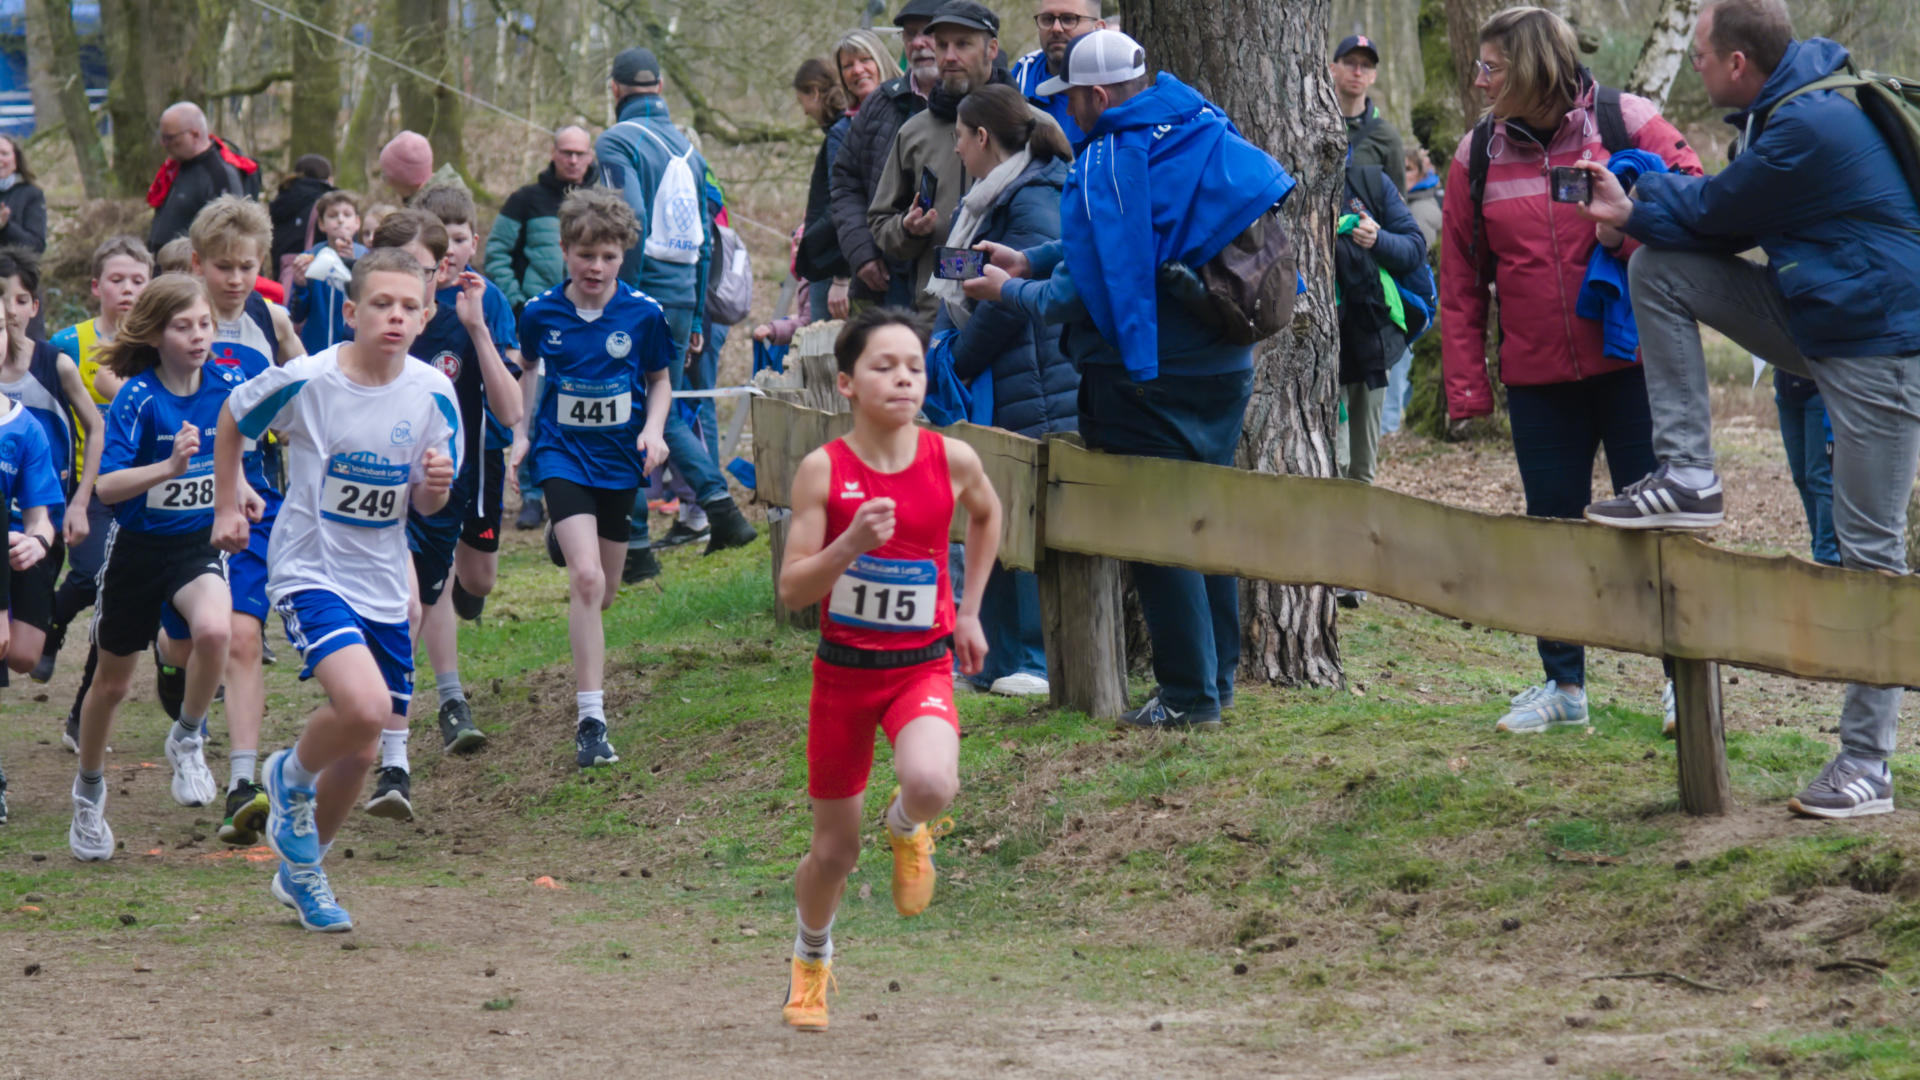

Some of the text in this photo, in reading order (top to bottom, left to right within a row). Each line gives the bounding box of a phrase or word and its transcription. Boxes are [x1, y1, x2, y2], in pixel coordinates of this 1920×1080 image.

[570, 400, 617, 424] 441
[163, 479, 213, 507] 238
[337, 484, 396, 518] 249
[852, 584, 916, 622] 115
